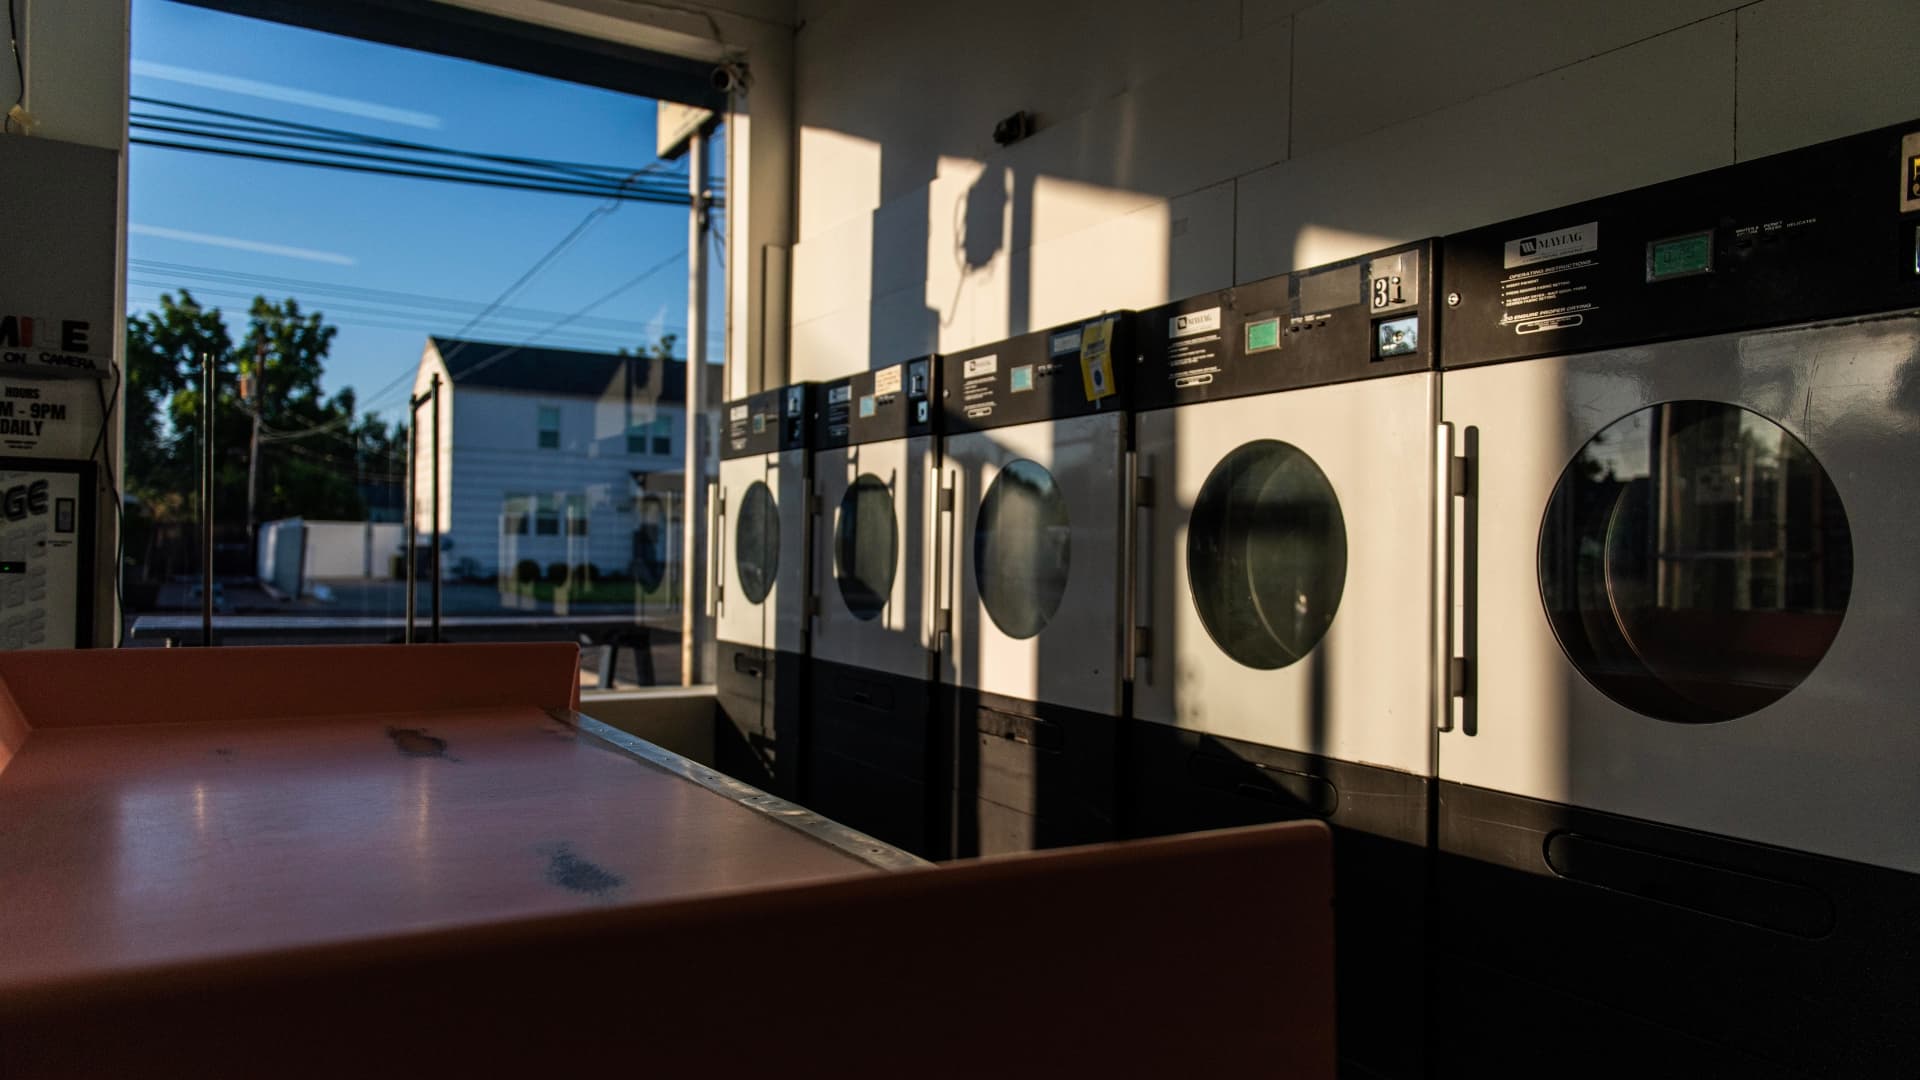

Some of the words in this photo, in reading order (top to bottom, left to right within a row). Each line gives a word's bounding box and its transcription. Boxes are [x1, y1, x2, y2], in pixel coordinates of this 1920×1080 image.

[1538, 232, 1582, 249] MAYTAG
[3, 351, 27, 363] ON
[39, 351, 97, 370] CAMERA
[5, 384, 40, 398] HOURS
[30, 402, 66, 420] 9PM
[0, 418, 42, 436] DAILY
[0, 479, 48, 521] GE
